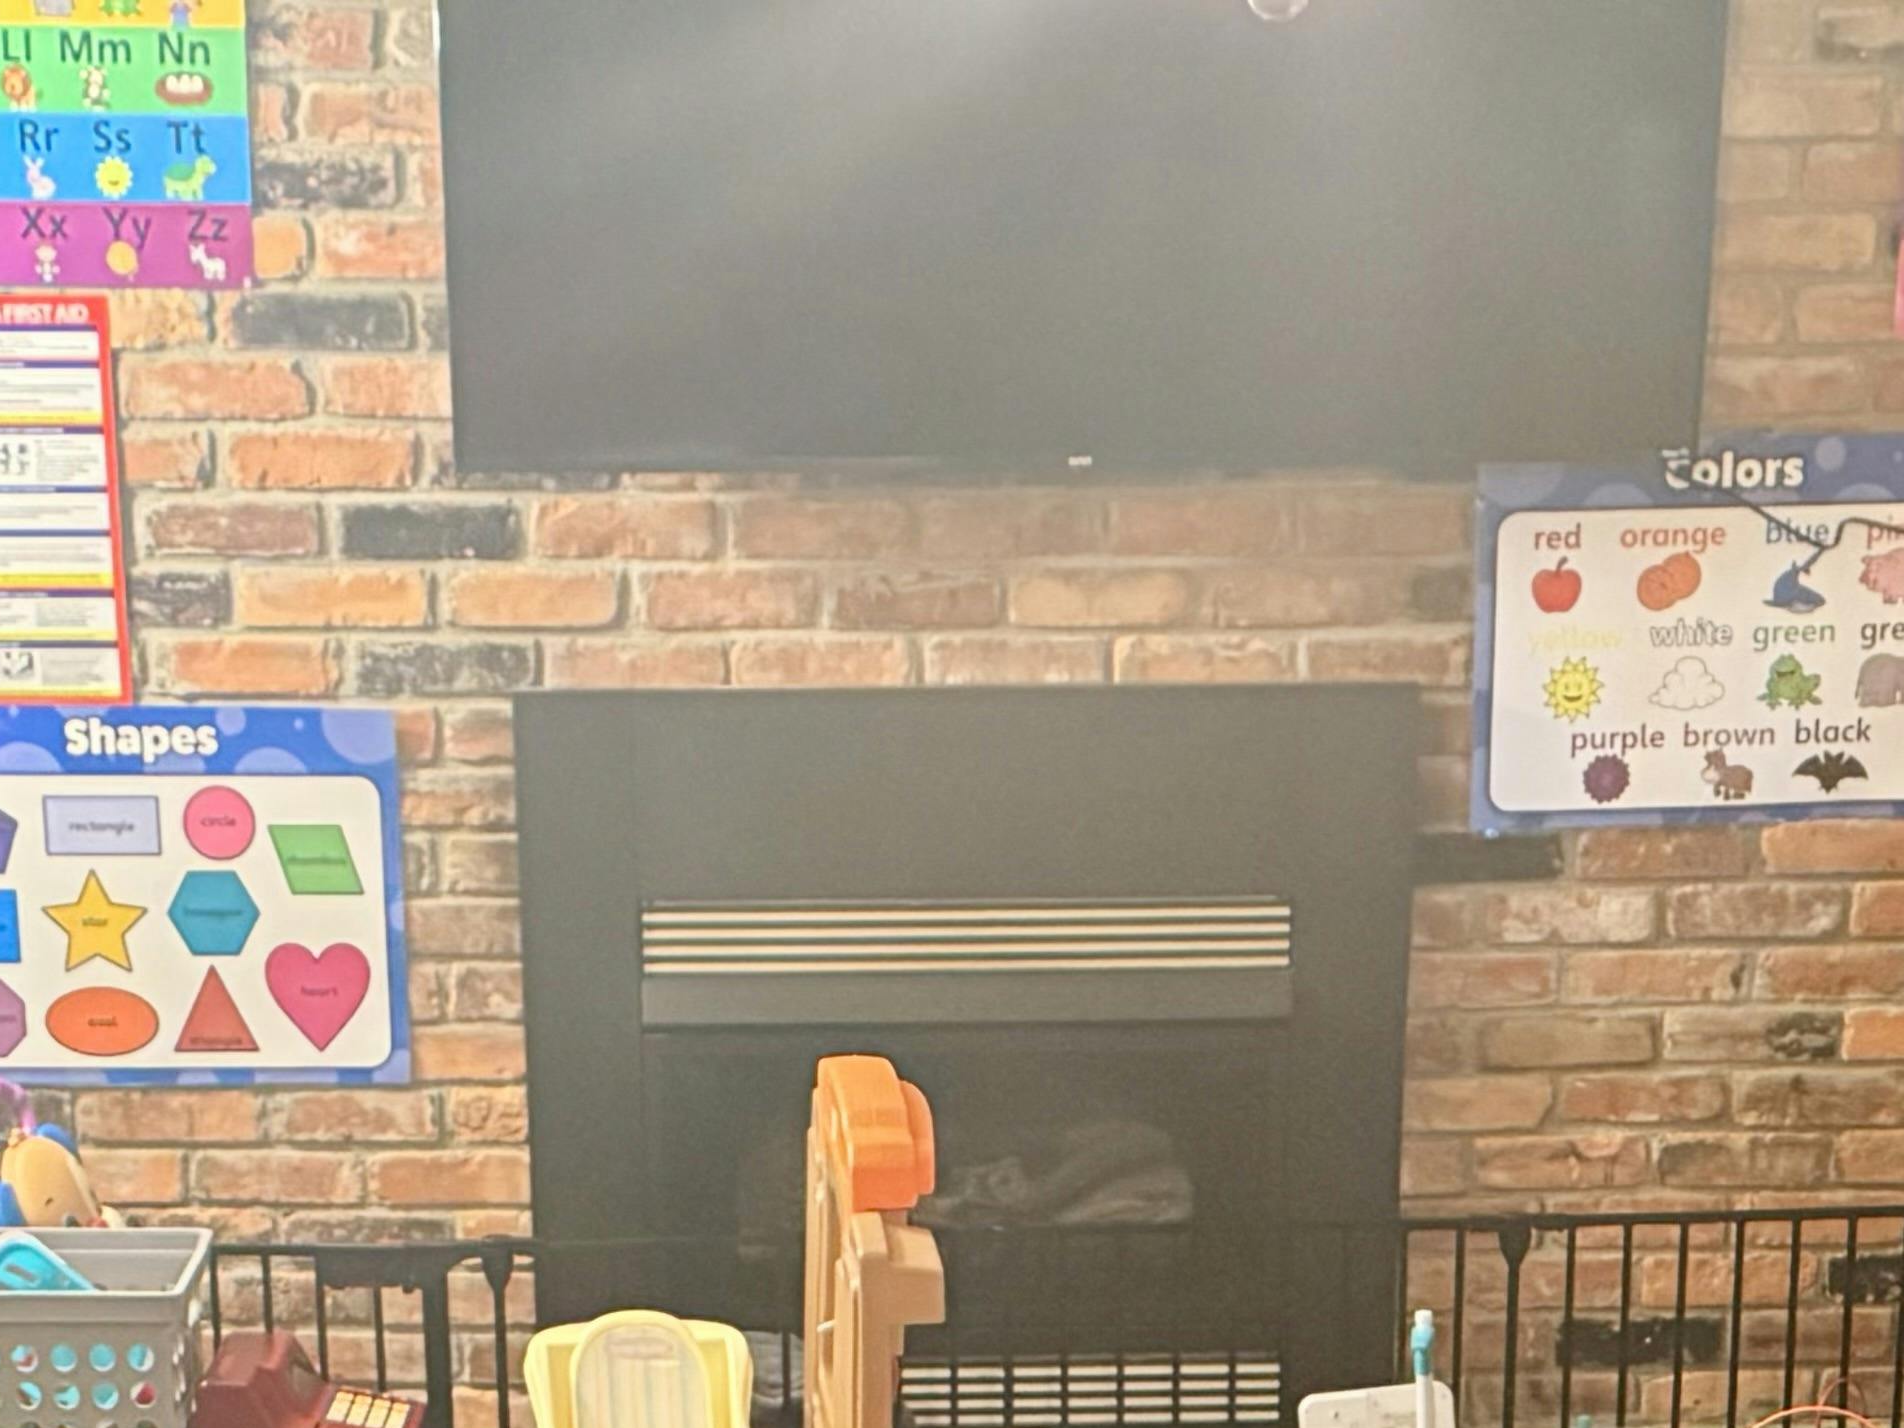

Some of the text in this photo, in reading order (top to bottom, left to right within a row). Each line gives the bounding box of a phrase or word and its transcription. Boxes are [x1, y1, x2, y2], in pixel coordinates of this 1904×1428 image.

[59, 29, 132, 64] Mm
[158, 31, 211, 65] Nn
[19, 121, 59, 153] Rr
[93, 122, 132, 154] Ss
[166, 121, 206, 154] Tt
[21, 208, 68, 240] Xx
[101, 207, 151, 249] Yy
[186, 208, 228, 242] Zz
[1662, 448, 1804, 492] Colors
[1534, 523, 1582, 550] red
[1619, 523, 1727, 553] orange
[1765, 519, 1829, 547] blue
[1650, 618, 1734, 648] white
[1752, 622, 1837, 651] green
[63, 716, 220, 764] Shapes
[1570, 718, 1873, 758] purple brown black
[67, 819, 136, 836] rectangle
